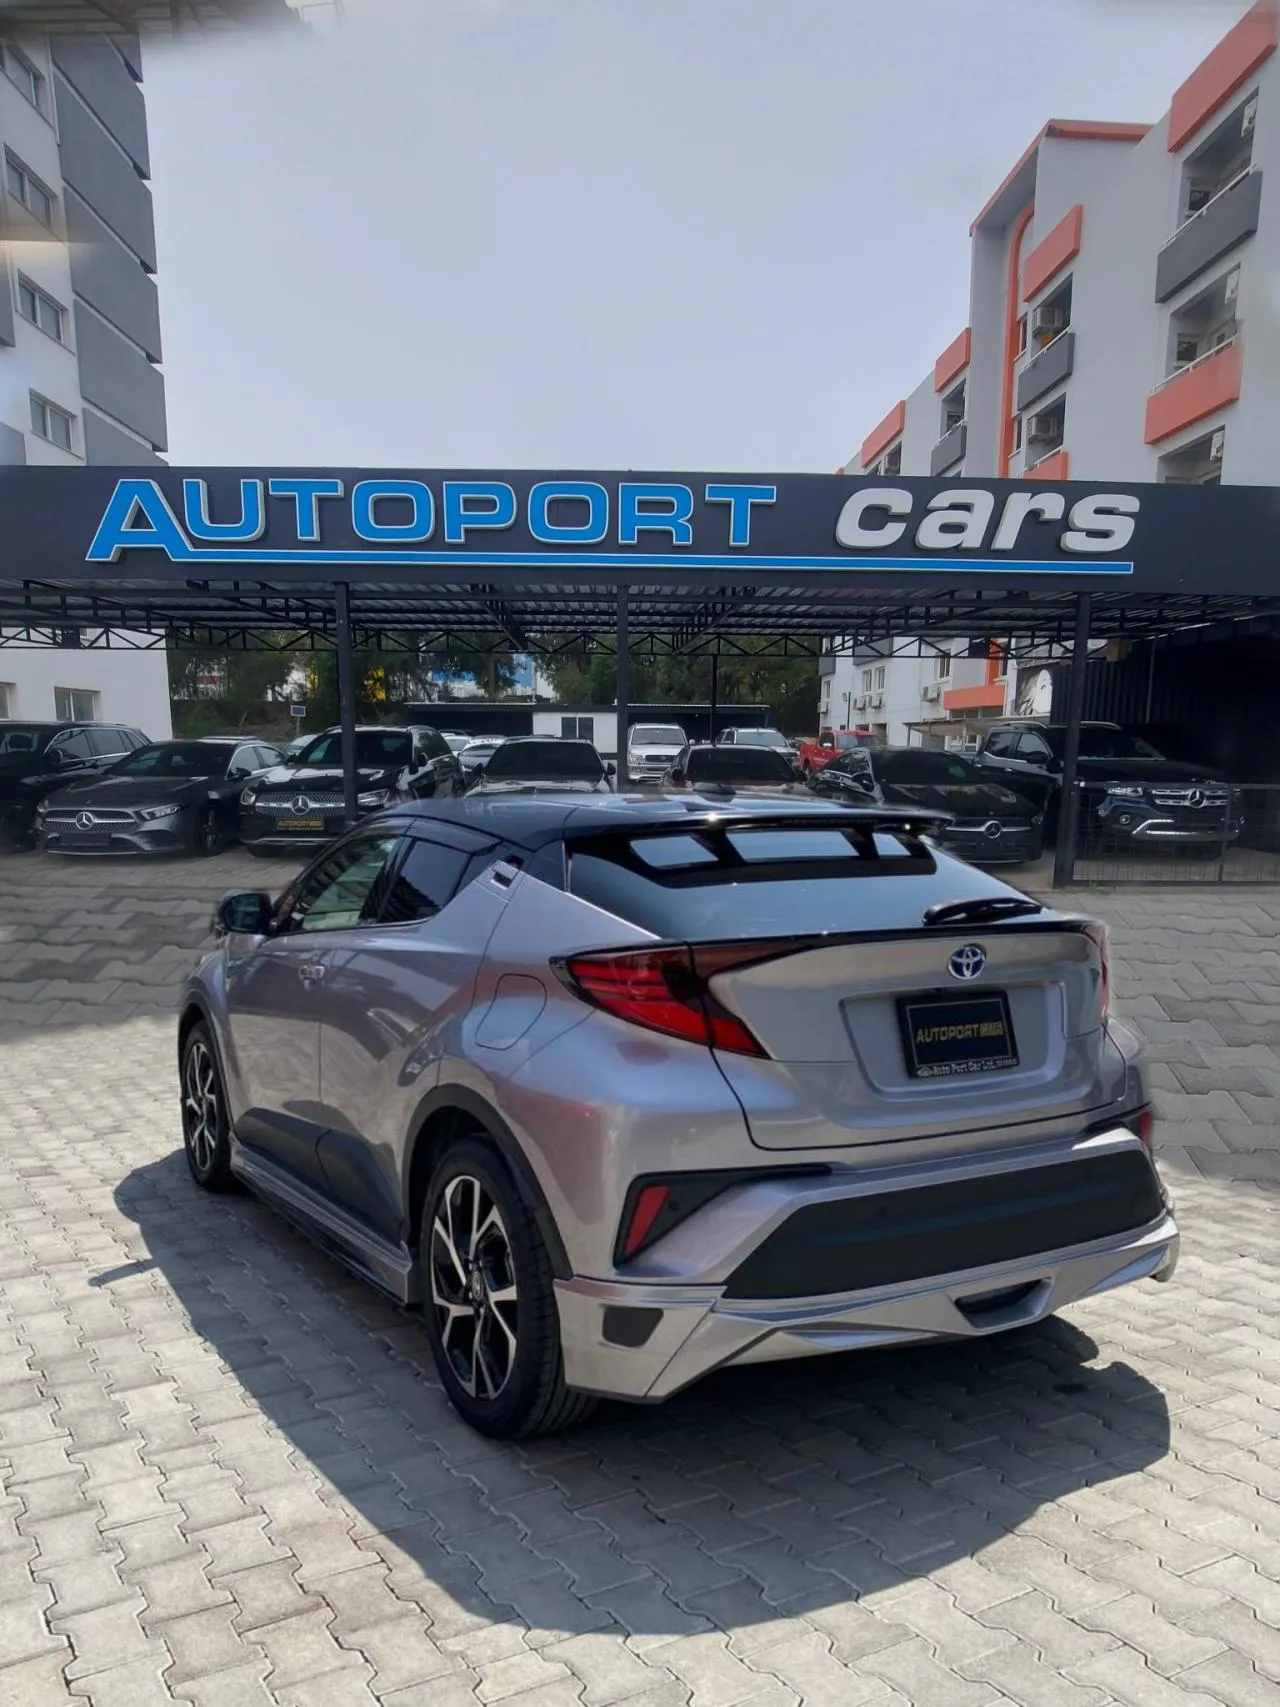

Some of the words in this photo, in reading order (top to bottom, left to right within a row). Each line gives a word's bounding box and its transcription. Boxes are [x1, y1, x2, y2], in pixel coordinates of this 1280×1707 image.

[85, 478, 777, 561] AUTOPORT
[835, 487, 1141, 553] cars
[916, 1024, 979, 1042] AUTOPORT
